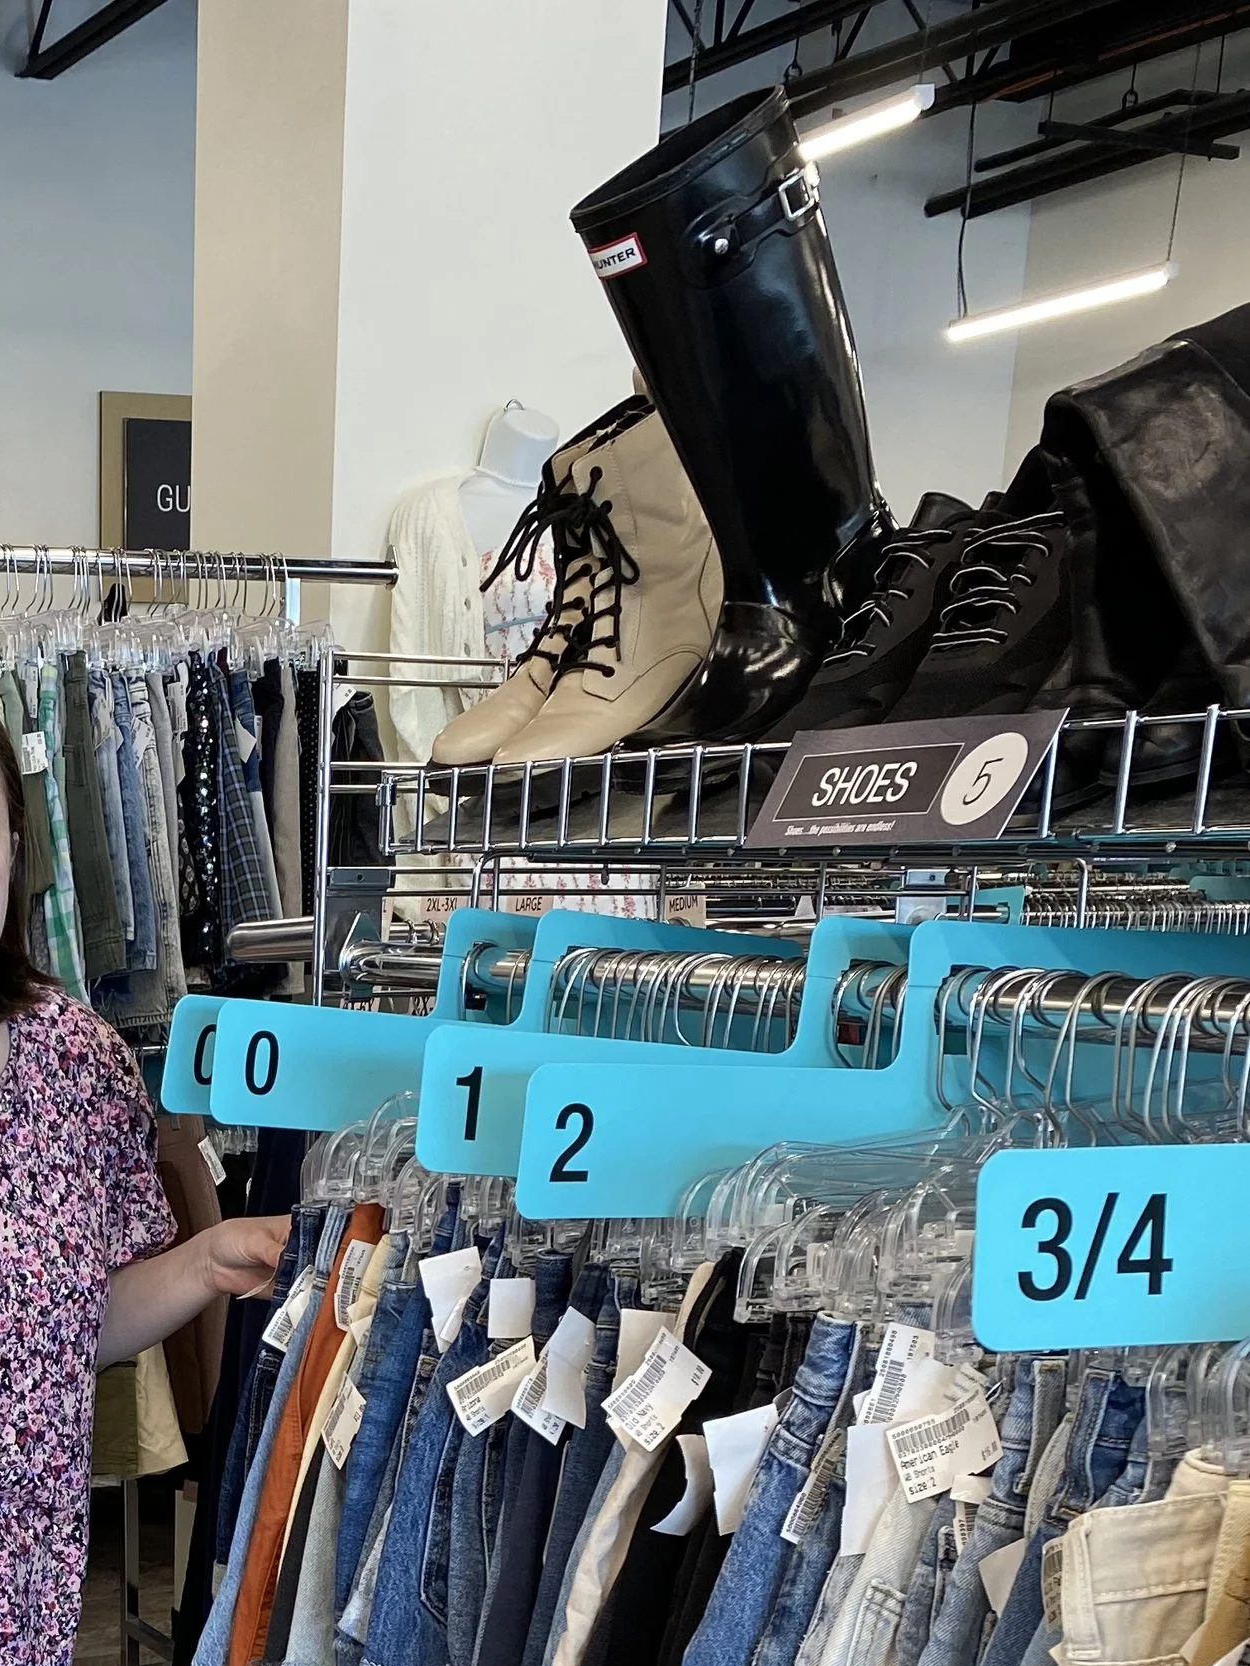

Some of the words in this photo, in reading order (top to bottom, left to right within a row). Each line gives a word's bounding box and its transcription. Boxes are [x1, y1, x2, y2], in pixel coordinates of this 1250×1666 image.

[595, 247, 637, 270] UNTER
[811, 761, 918, 808] SHOES
[961, 757, 1005, 806] 5
[515, 896, 542, 913] LARGE
[668, 894, 699, 914] MEDIUM
[244, 1030, 280, 1096] 0
[455, 1066, 484, 1141] 1
[549, 1102, 595, 1183] 2
[1017, 1192, 1174, 1302] 3/4
[625, 1417, 640, 1431] Old
[636, 1402, 655, 1418] Navy
[900, 1450, 939, 1470] American
[938, 1440, 960, 1456] Eagle
